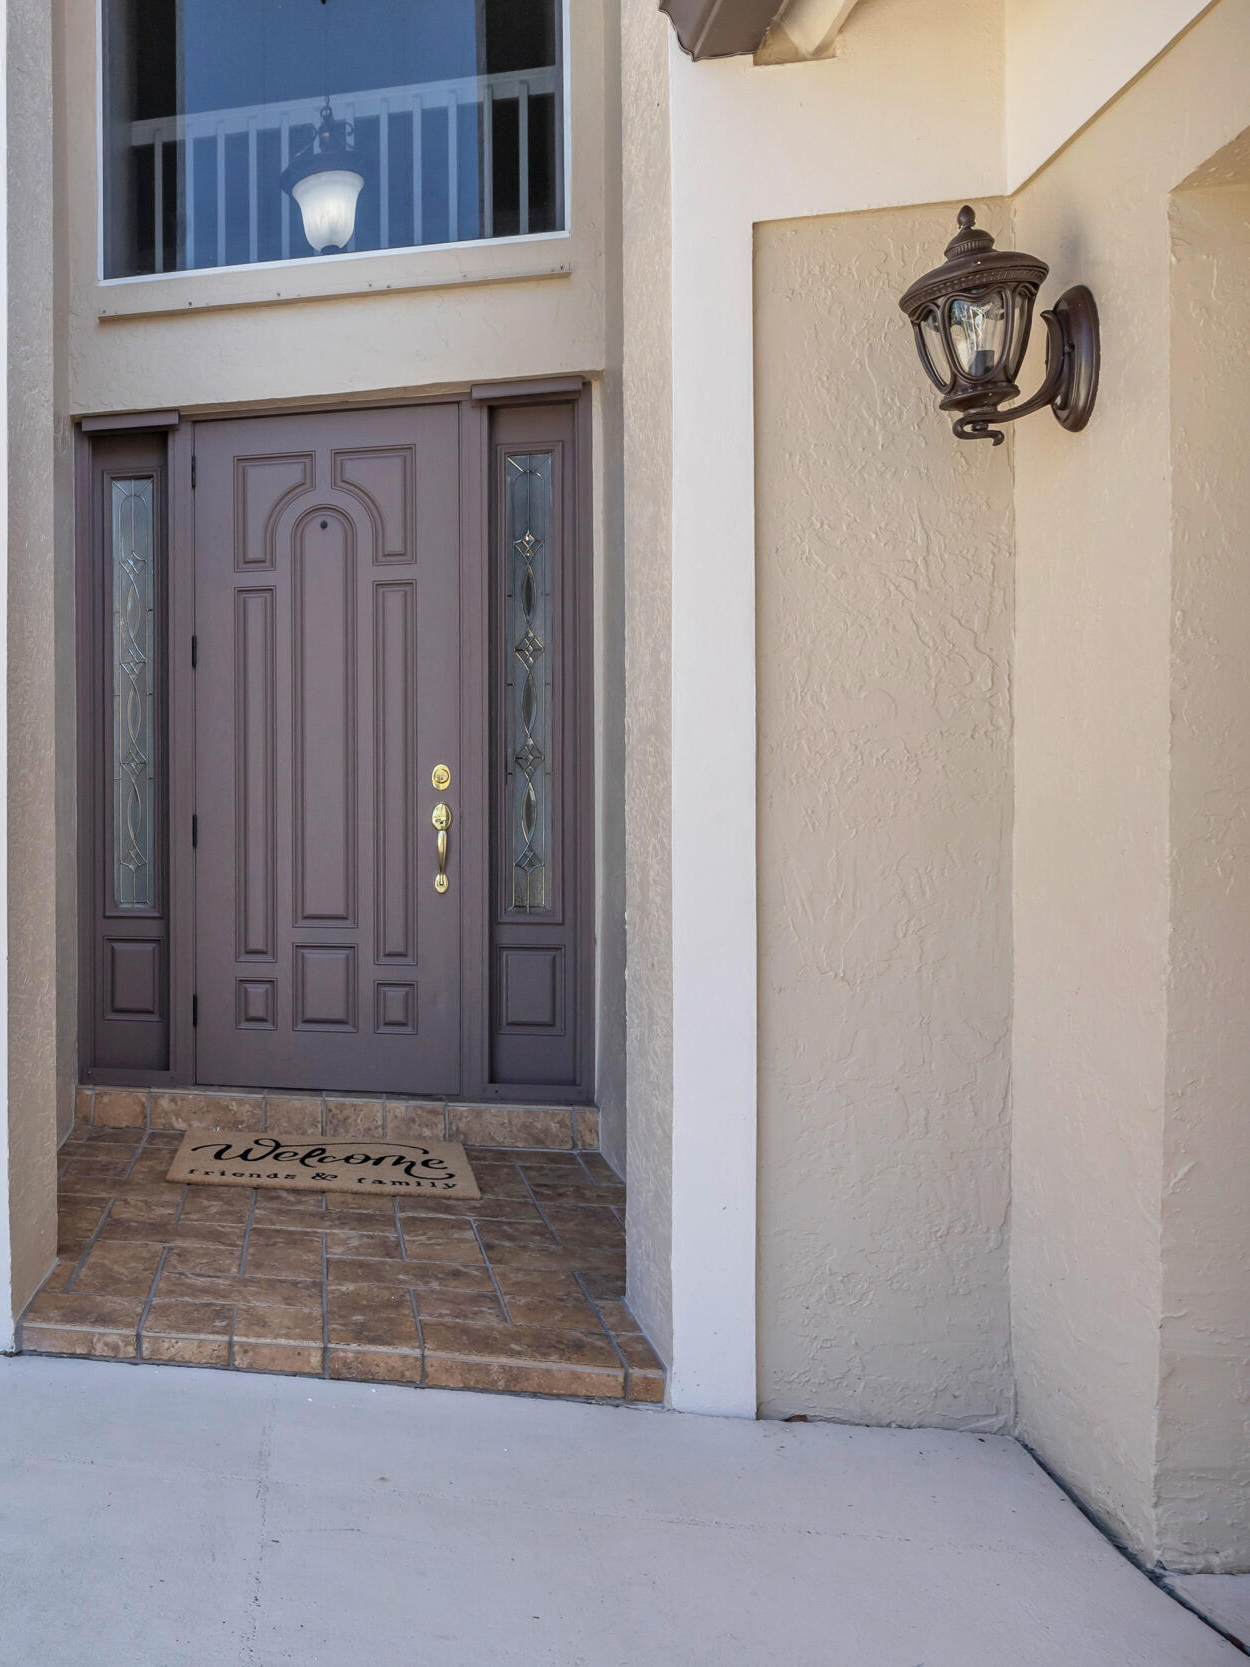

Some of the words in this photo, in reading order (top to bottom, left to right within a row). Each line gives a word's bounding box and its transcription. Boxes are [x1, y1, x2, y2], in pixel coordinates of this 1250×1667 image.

[191, 1137, 455, 1180] Welcome
[188, 1168, 296, 1180] friends
[310, 1171, 339, 1182] &
[356, 1177, 458, 1190] family
